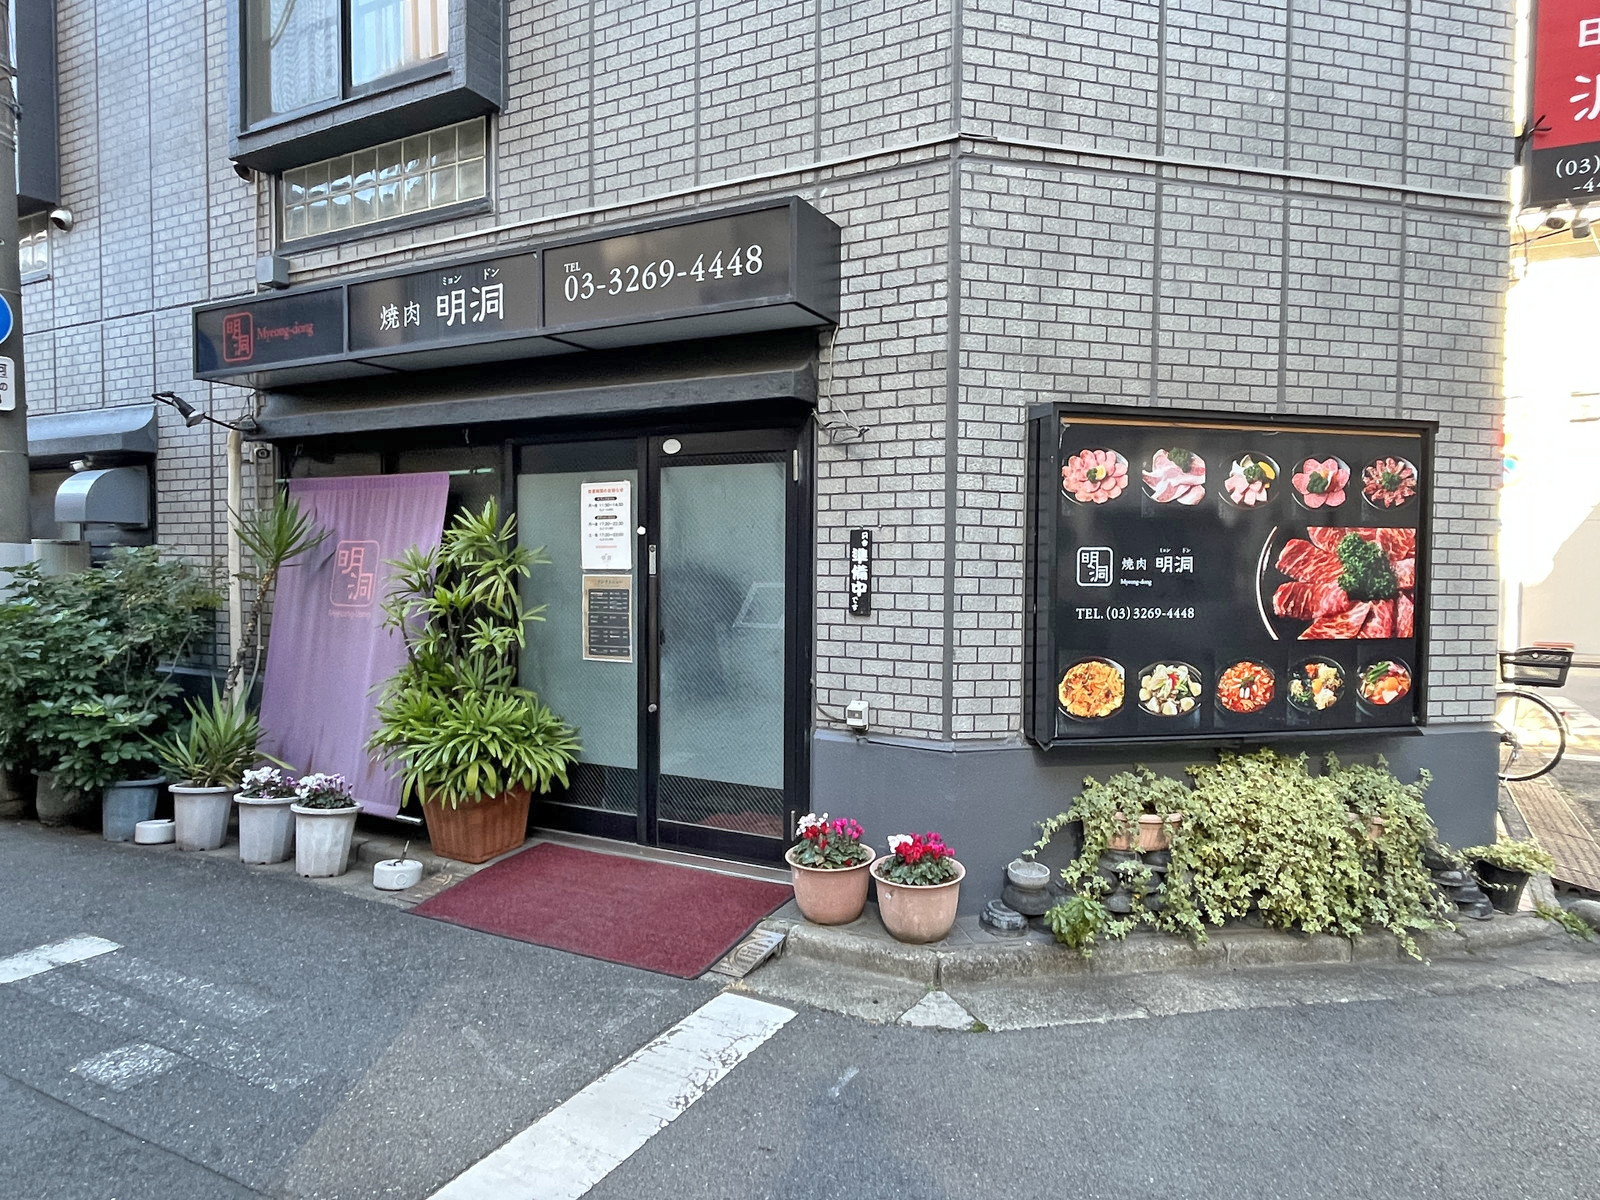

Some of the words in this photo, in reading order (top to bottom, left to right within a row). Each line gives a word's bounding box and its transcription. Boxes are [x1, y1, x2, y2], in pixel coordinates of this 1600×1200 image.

[564, 262, 581, 273] TEL
[564, 244, 764, 302] 03-3269-4448
[379, 301, 421, 331] 焼肉
[436, 282, 505, 327] 明洞
[337, 546, 374, 601] 明洞
[1081, 551, 1109, 583] 明洞
[1121, 557, 1147, 571] 焼肉
[1155, 555, 1194, 573] 明洞
[1076, 607, 1104, 619] TEL.
[1106, 606, 1131, 620] (03)
[1133, 607, 1195, 619] 3269-4448
